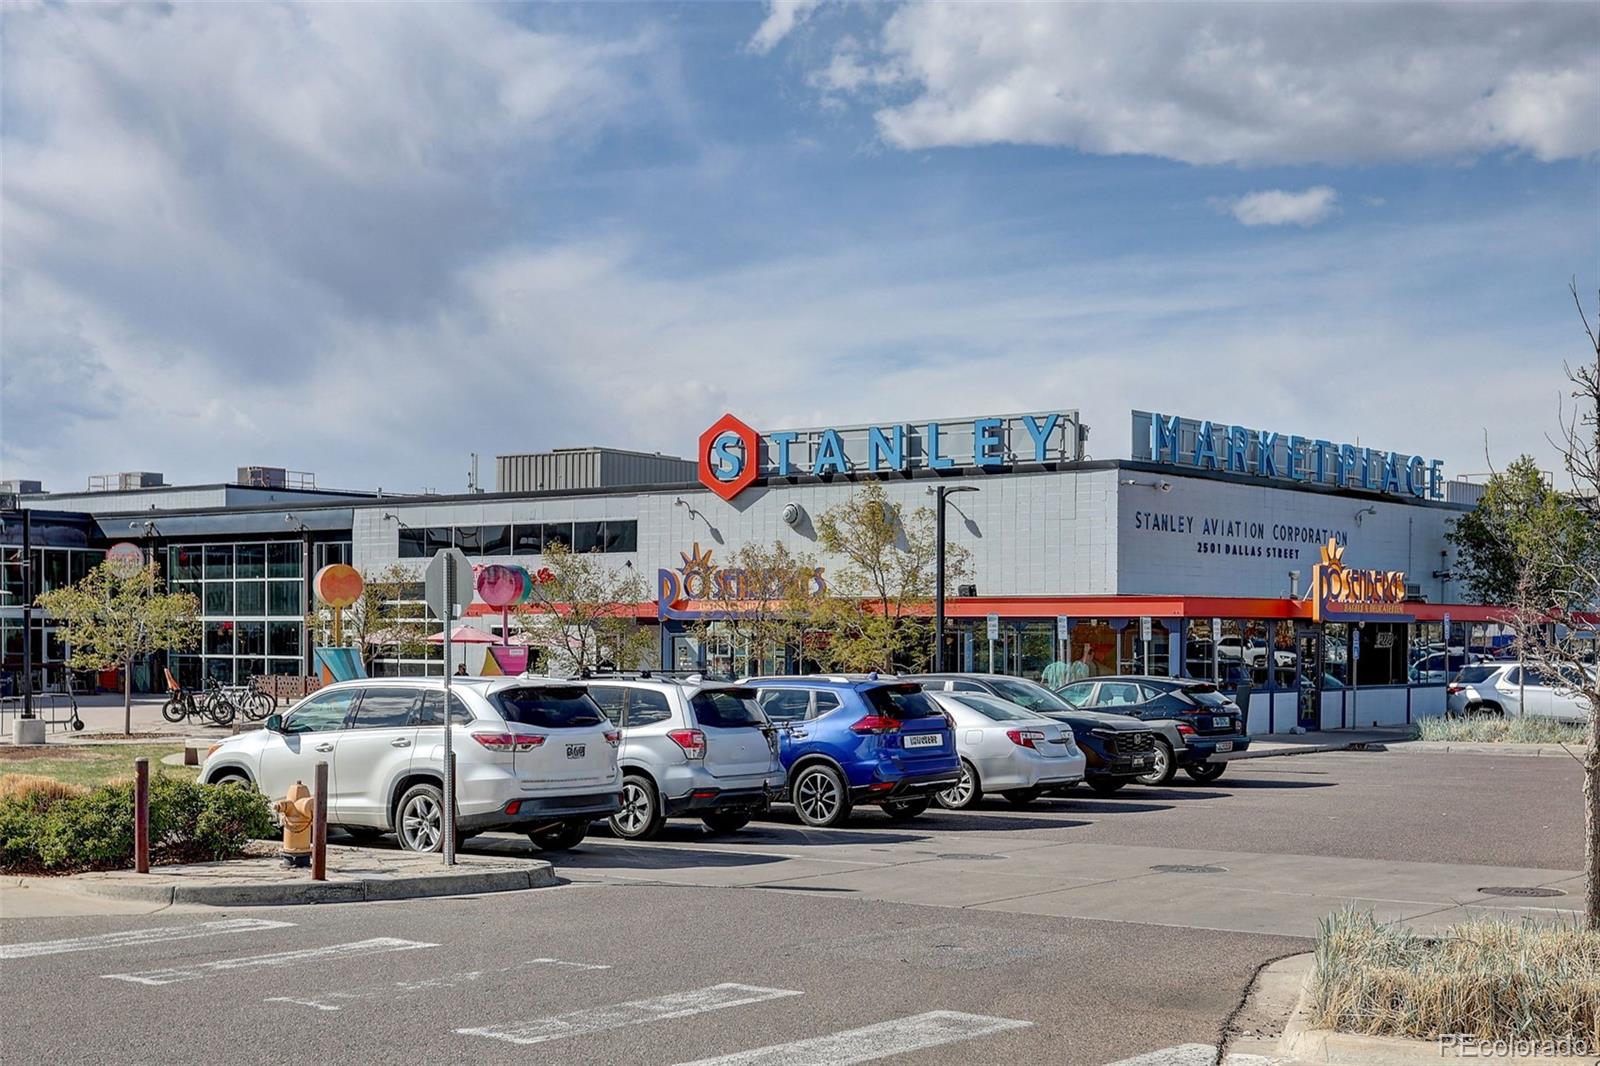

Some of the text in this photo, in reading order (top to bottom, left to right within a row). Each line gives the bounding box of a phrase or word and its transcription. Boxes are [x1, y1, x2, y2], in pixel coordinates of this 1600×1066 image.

[714, 413, 1062, 479] STANLEY
[1150, 412, 1445, 500] MARKETPLACE
[1135, 511, 1349, 547] STANLEY AVIATION CORPORATION
[1197, 542, 1299, 560] 2501 DALLAS STREET
